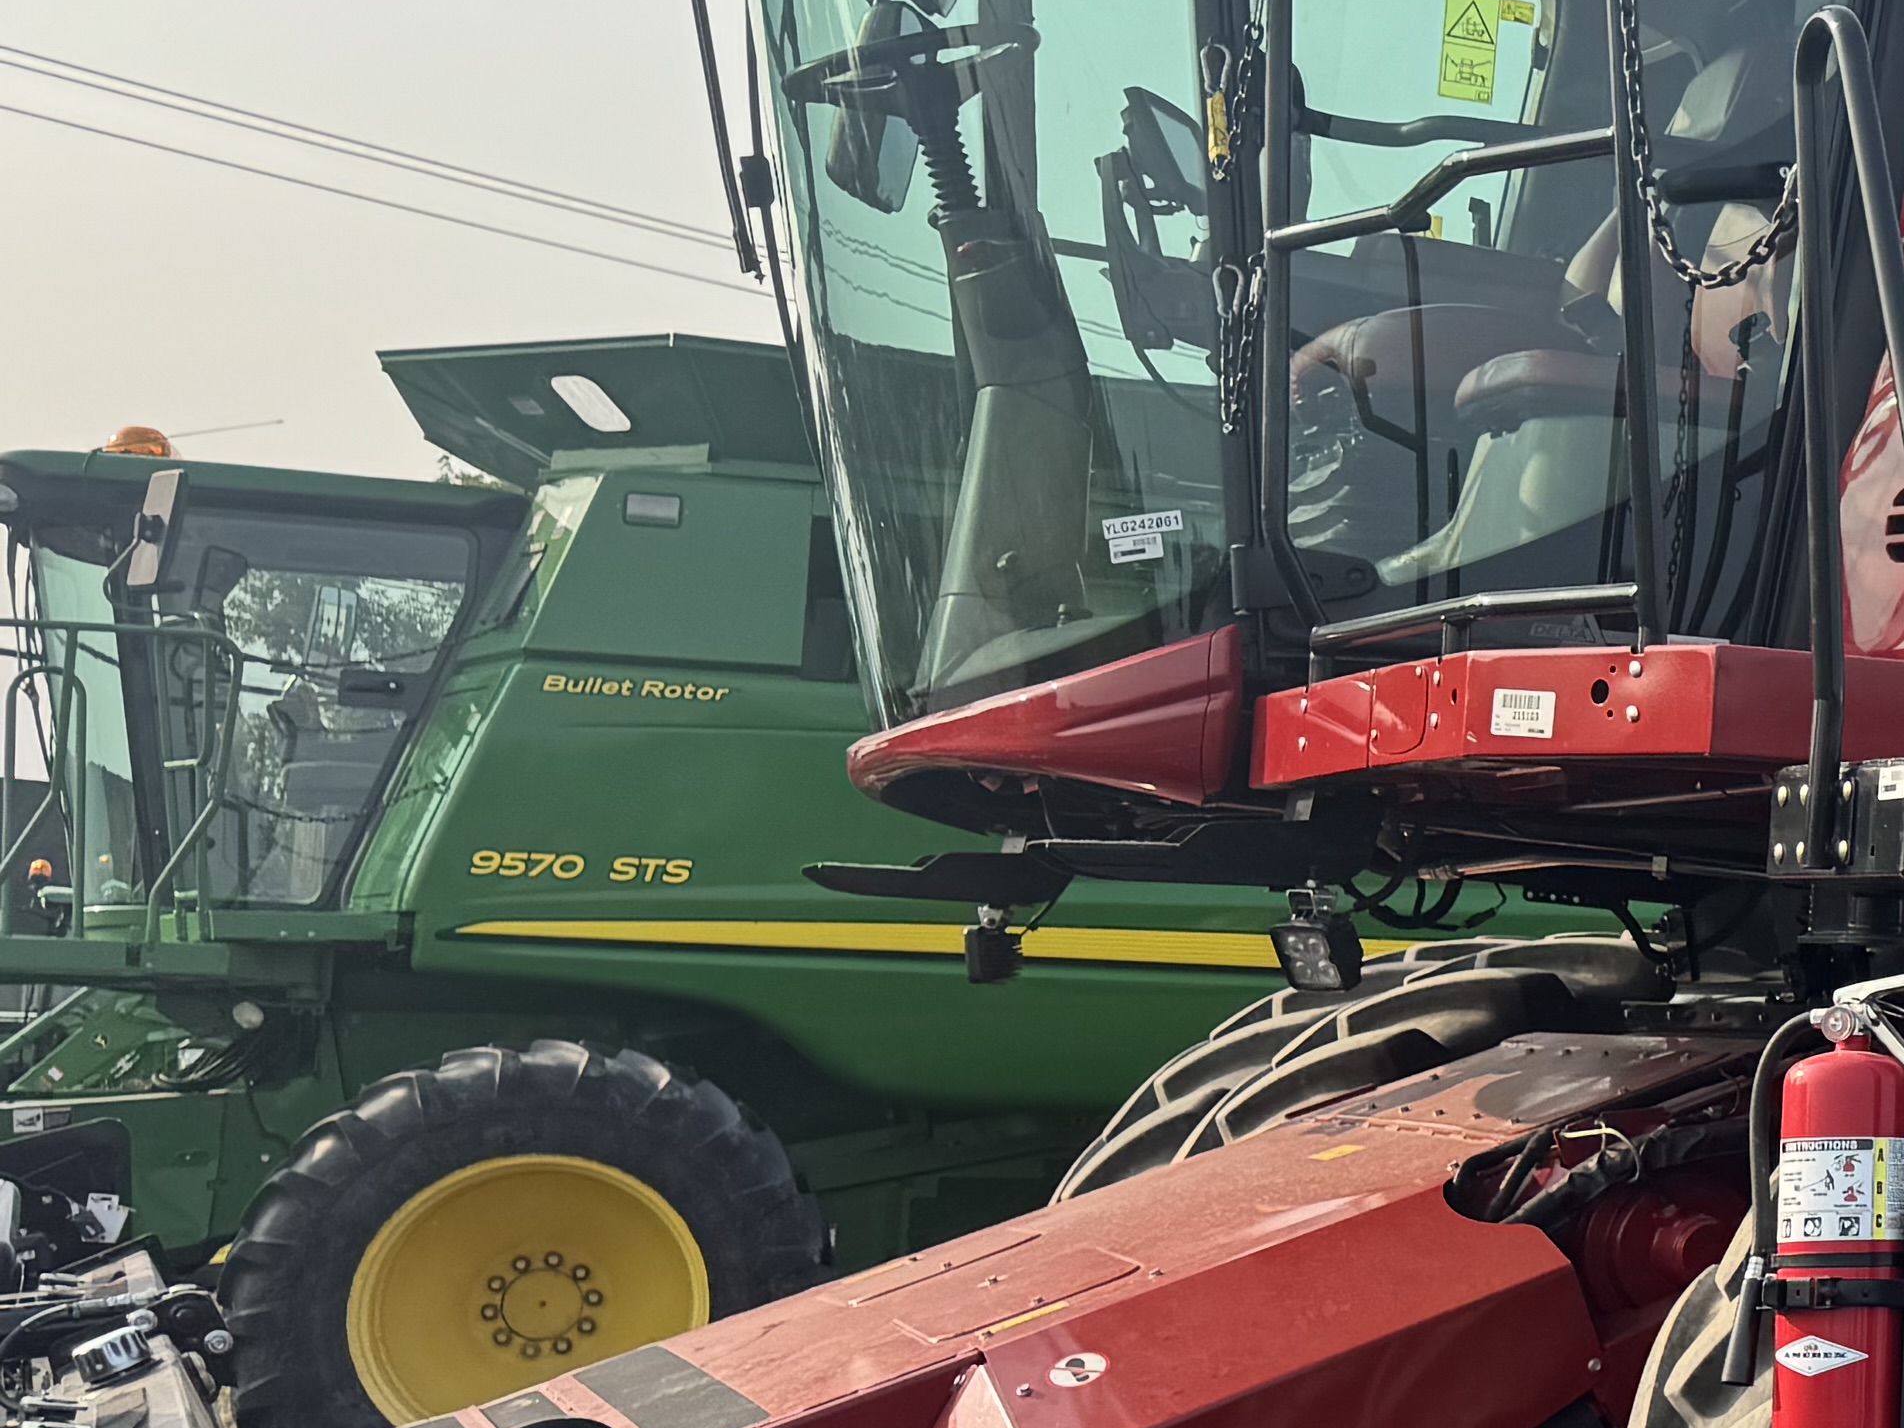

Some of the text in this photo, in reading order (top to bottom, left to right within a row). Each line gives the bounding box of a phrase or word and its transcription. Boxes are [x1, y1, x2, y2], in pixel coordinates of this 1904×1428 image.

[542, 674, 729, 701] Bullet Rotor
[470, 850, 693, 884] 9570 STS
[1877, 1147, 1885, 1162] A
